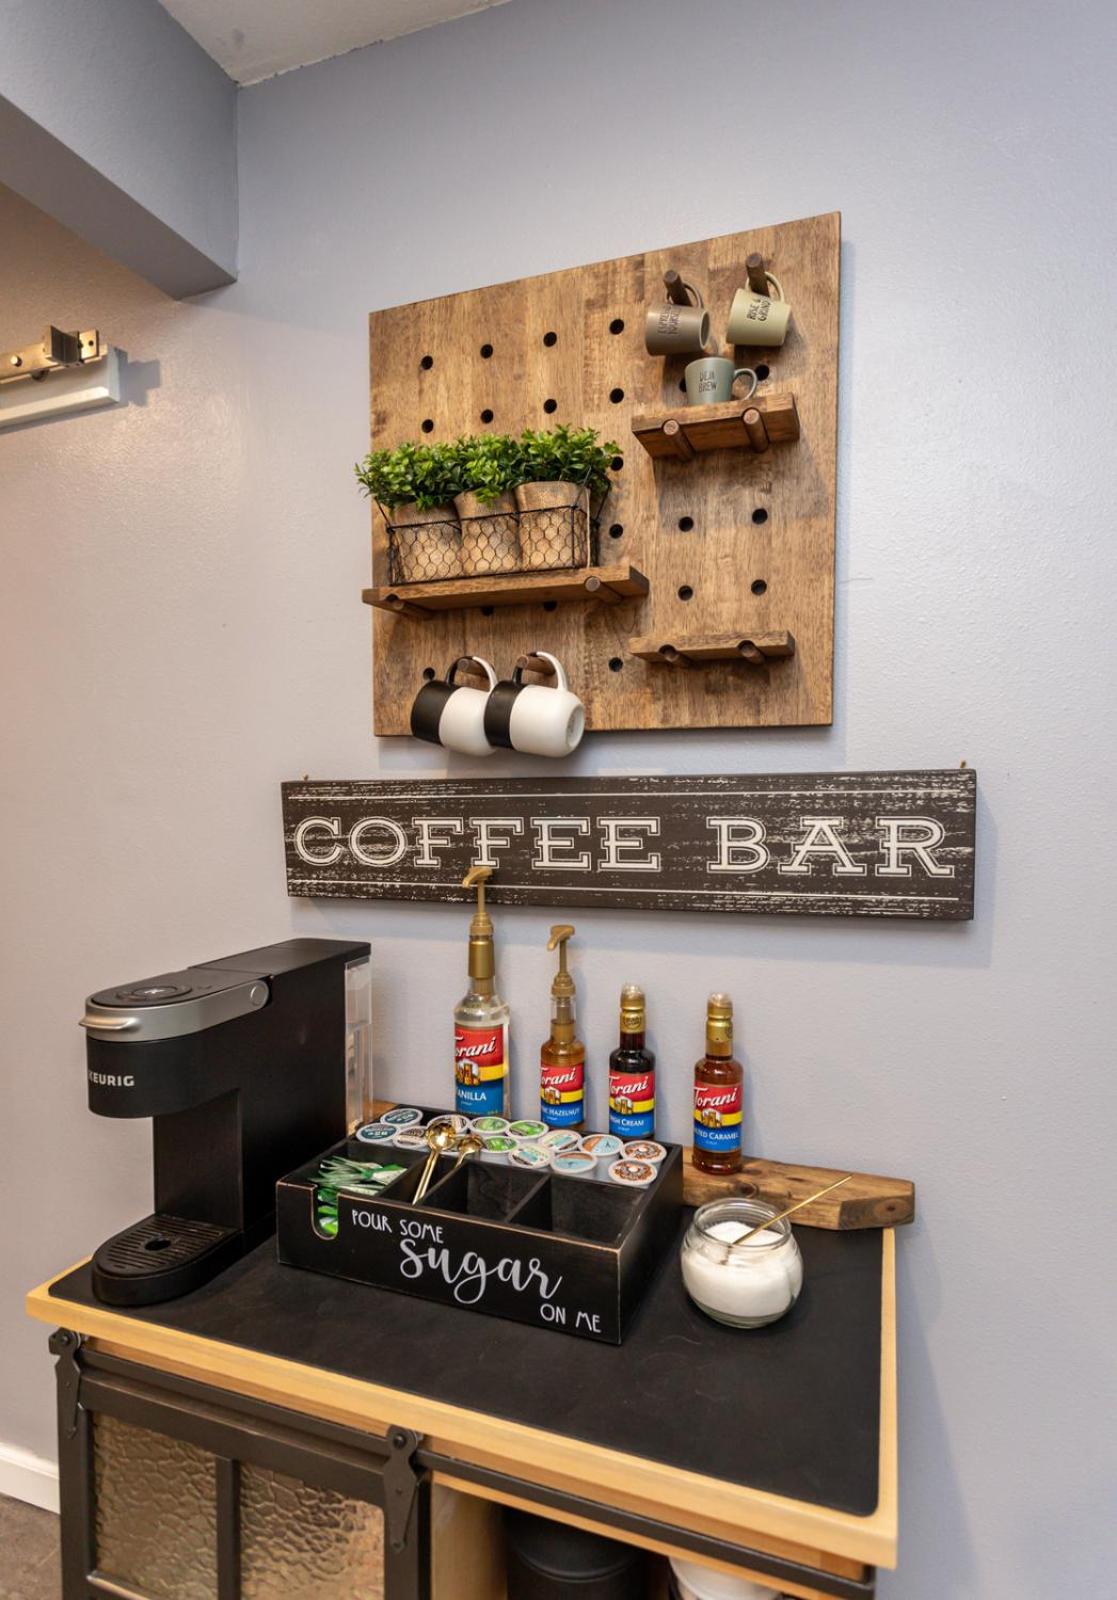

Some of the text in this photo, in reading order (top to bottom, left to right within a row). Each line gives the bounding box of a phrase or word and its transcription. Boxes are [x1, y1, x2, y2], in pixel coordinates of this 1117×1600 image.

[292, 815, 957, 878] COFFEE BAR
[454, 1035, 496, 1056] rani
[456, 1089, 487, 1101] ANILLA
[694, 1086, 738, 1107] Torani
[621, 1118, 644, 1127] CREAM
[351, 1208, 444, 1244] POUR SOME
[399, 1238, 563, 1305] sugar
[539, 1303, 602, 1333] ON ME
